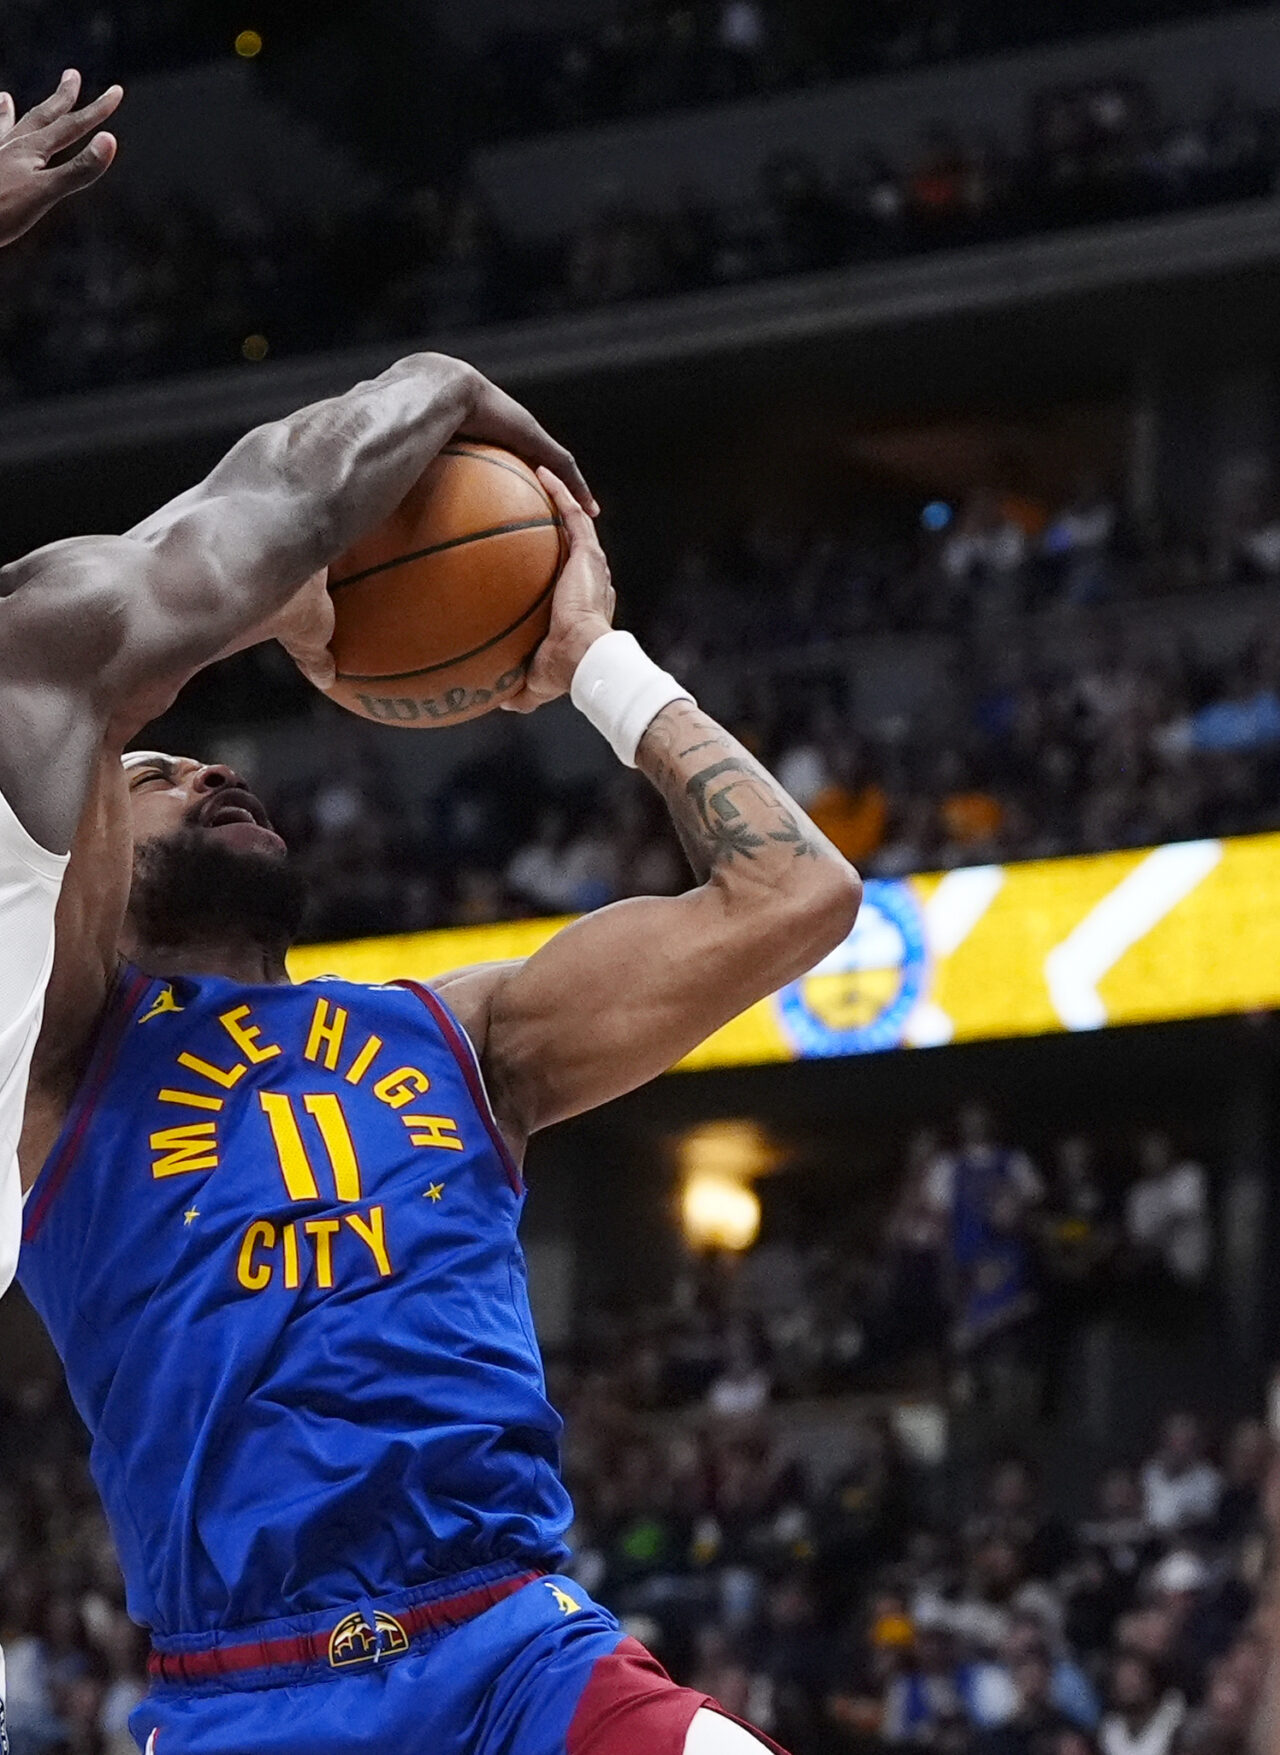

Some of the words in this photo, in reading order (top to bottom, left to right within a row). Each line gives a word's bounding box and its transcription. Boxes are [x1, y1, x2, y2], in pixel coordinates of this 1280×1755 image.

[355, 668, 523, 721] Wilso
[149, 1004, 283, 1179] MILE
[303, 997, 465, 1151] HIGH
[258, 1090, 363, 1203] 11
[235, 1205, 392, 1291] CITY
